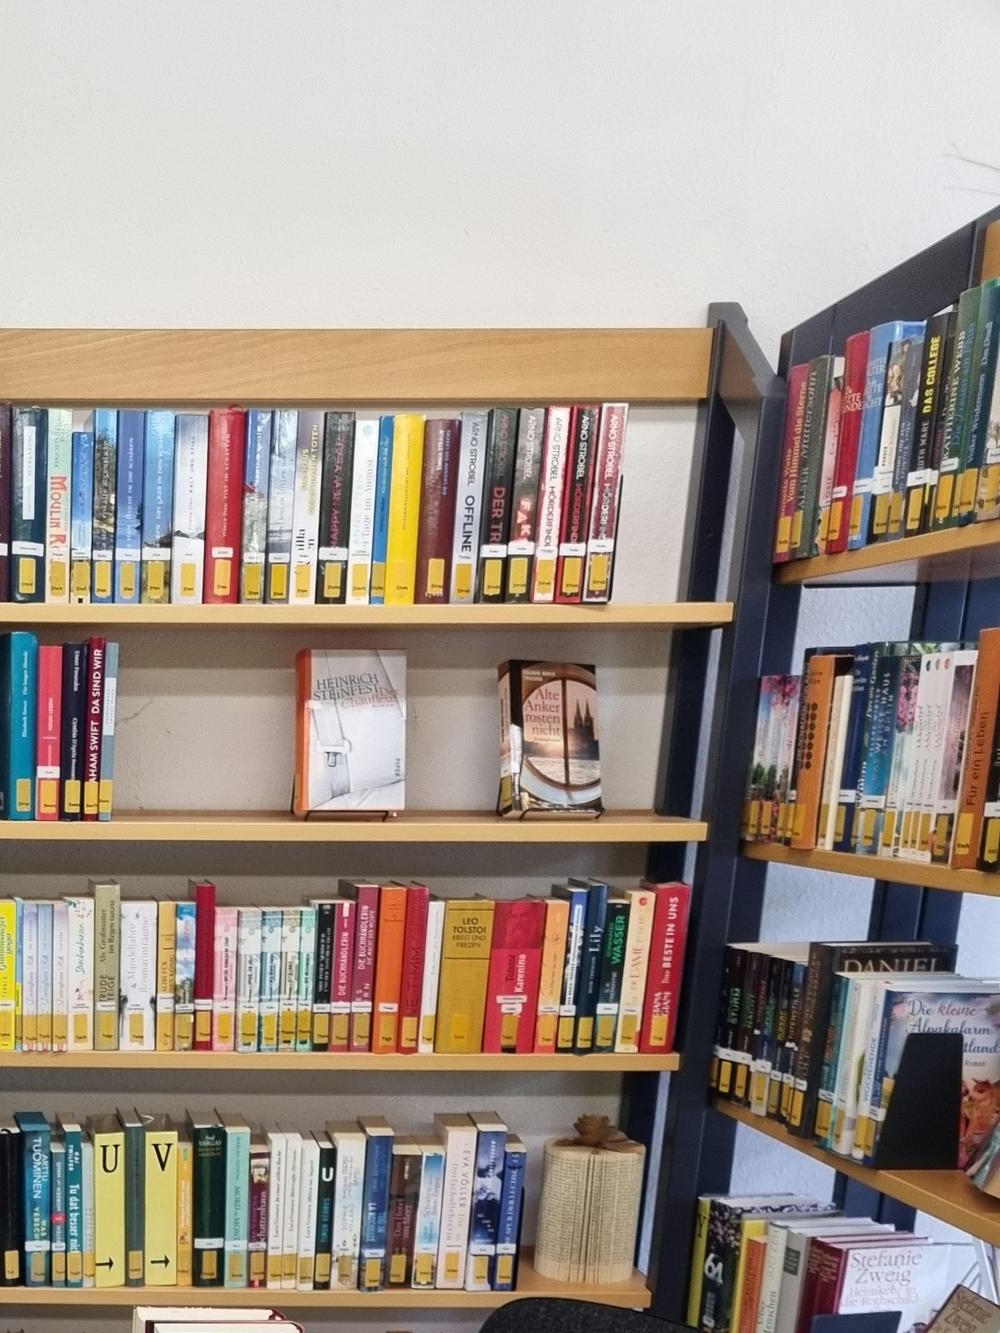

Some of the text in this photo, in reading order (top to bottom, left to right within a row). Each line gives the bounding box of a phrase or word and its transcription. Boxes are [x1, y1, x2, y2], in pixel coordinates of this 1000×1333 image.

[461, 495, 475, 553] OFFLINE
[90, 650, 102, 751] SWIFT DA SIND WIR
[526, 702, 560, 712] Anker
[535, 688, 559, 700] Alte
[526, 714, 560, 724] rosten
[462, 917, 478, 925] LEO
[611, 916, 627, 965] WASSER
[32, 1137, 42, 1199] TUOMINEN
[101, 1145, 119, 1172] U
[152, 1144, 173, 1171] V
